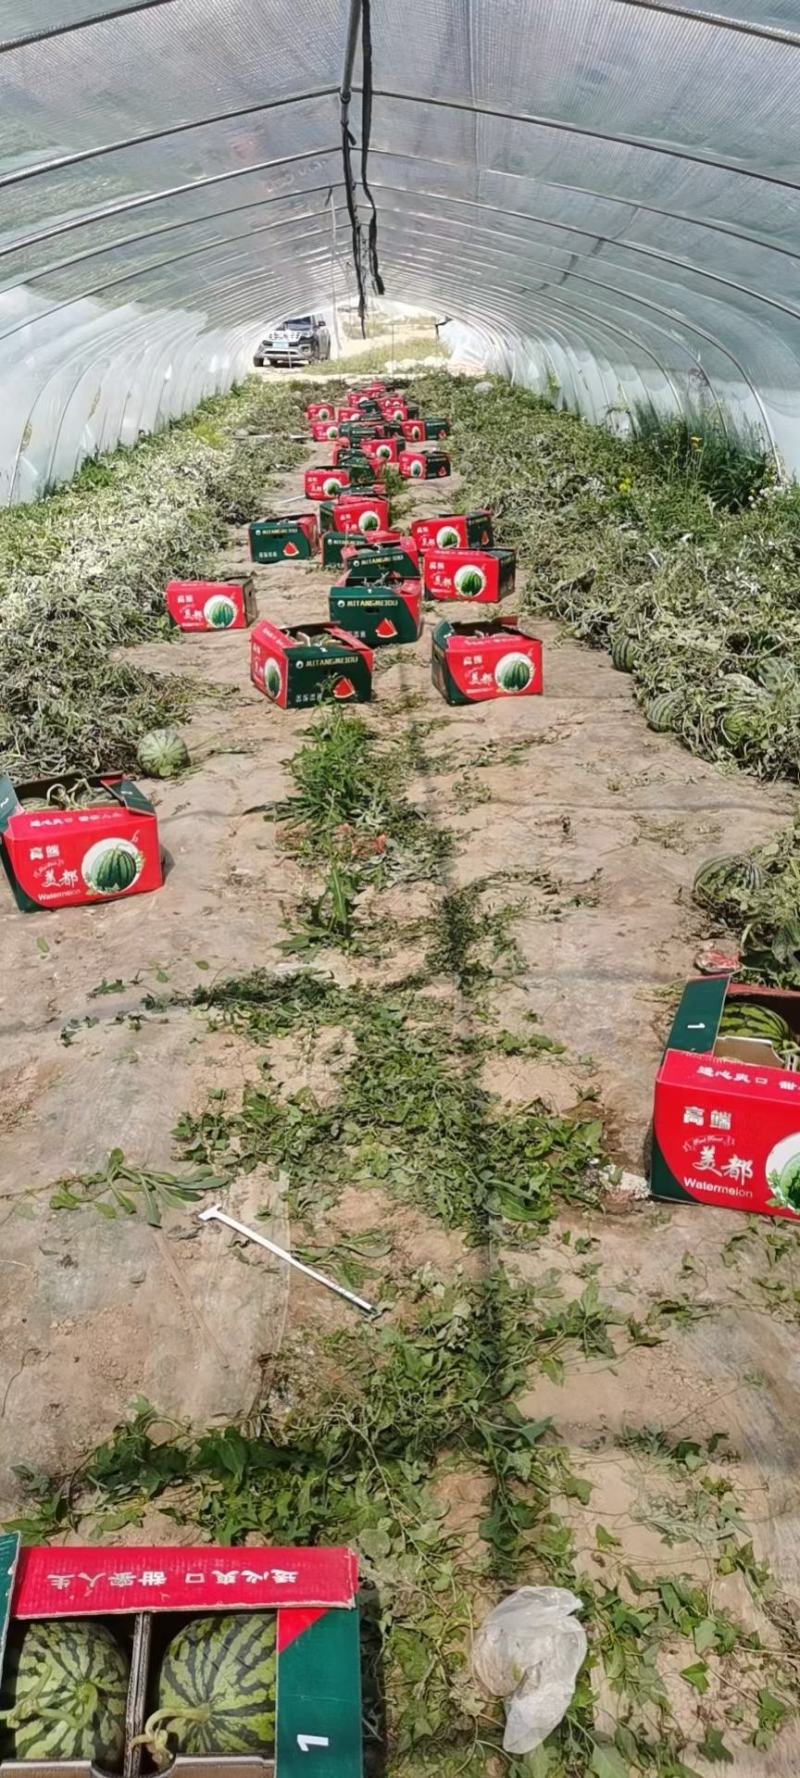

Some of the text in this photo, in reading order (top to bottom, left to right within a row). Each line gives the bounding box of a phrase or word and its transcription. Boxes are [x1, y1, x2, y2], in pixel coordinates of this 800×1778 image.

[41, 868, 79, 888] 美都
[683, 1105, 732, 1131] 高端
[691, 1145, 753, 1186] 美都
[683, 1176, 753, 1198] Watermelon
[46, 1568, 299, 1590] 透心爽口 甜蜜人生
[297, 1734, 329, 1752] 1
